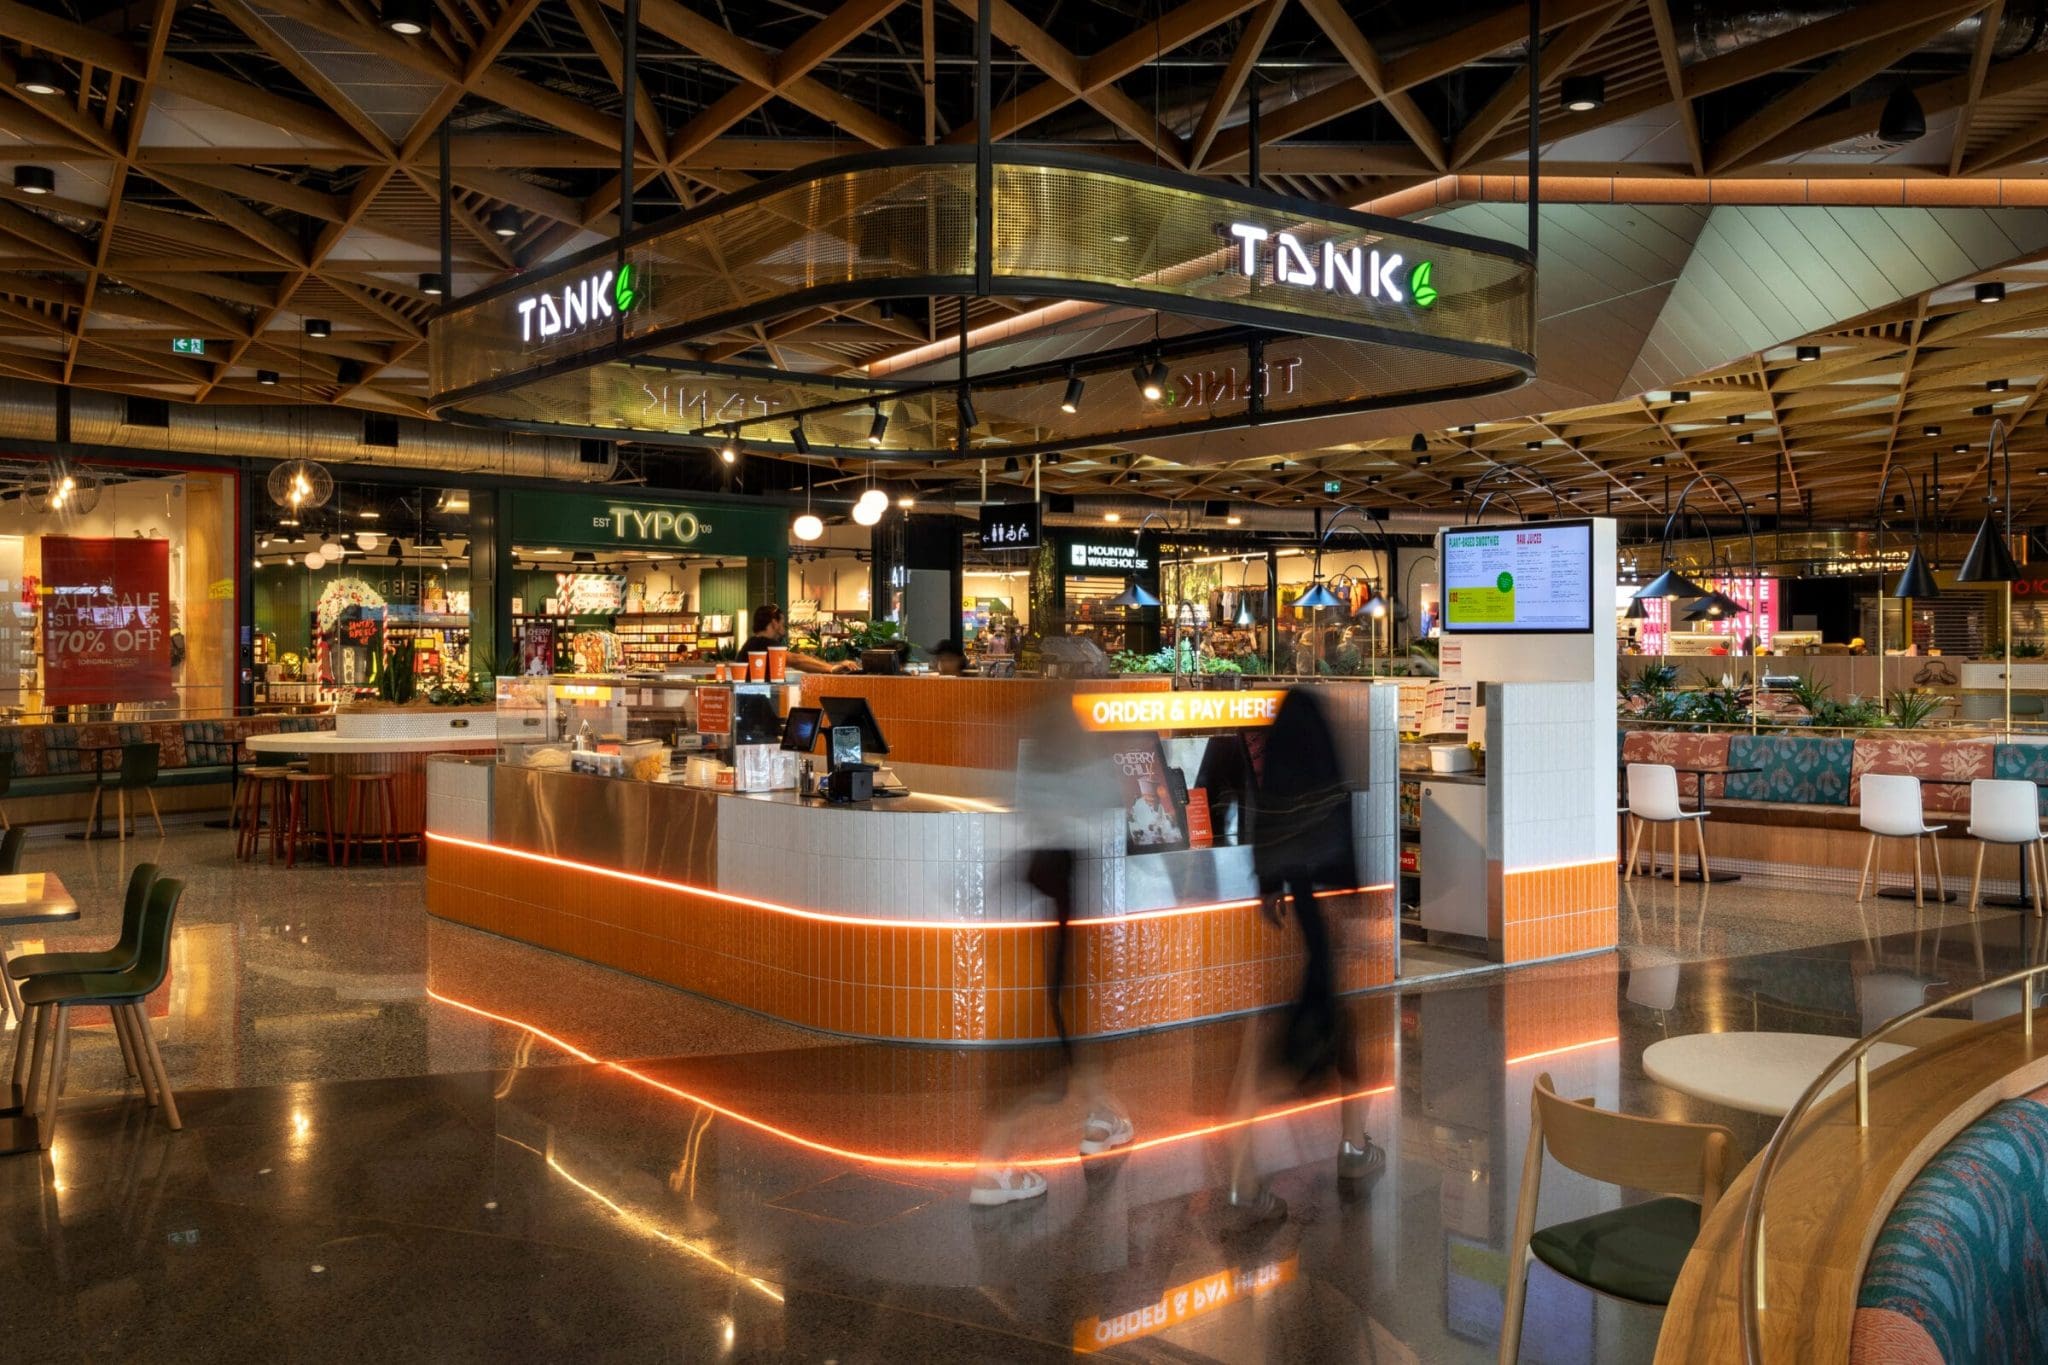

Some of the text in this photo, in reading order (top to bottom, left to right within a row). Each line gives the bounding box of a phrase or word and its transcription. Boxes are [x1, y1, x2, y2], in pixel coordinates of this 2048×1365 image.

[1231, 222, 1404, 302] TANK
[518, 269, 614, 342] TANK
[592, 516, 611, 528] EST
[608, 507, 700, 543] TYPO
[1087, 557, 1149, 569] WAREHOUSE
[106, 592, 160, 609] SALE
[54, 629, 161, 653] 70% OFF
[1093, 698, 1276, 723] ORDER & PAY HERE
[1113, 752, 1155, 765] CHERRY
